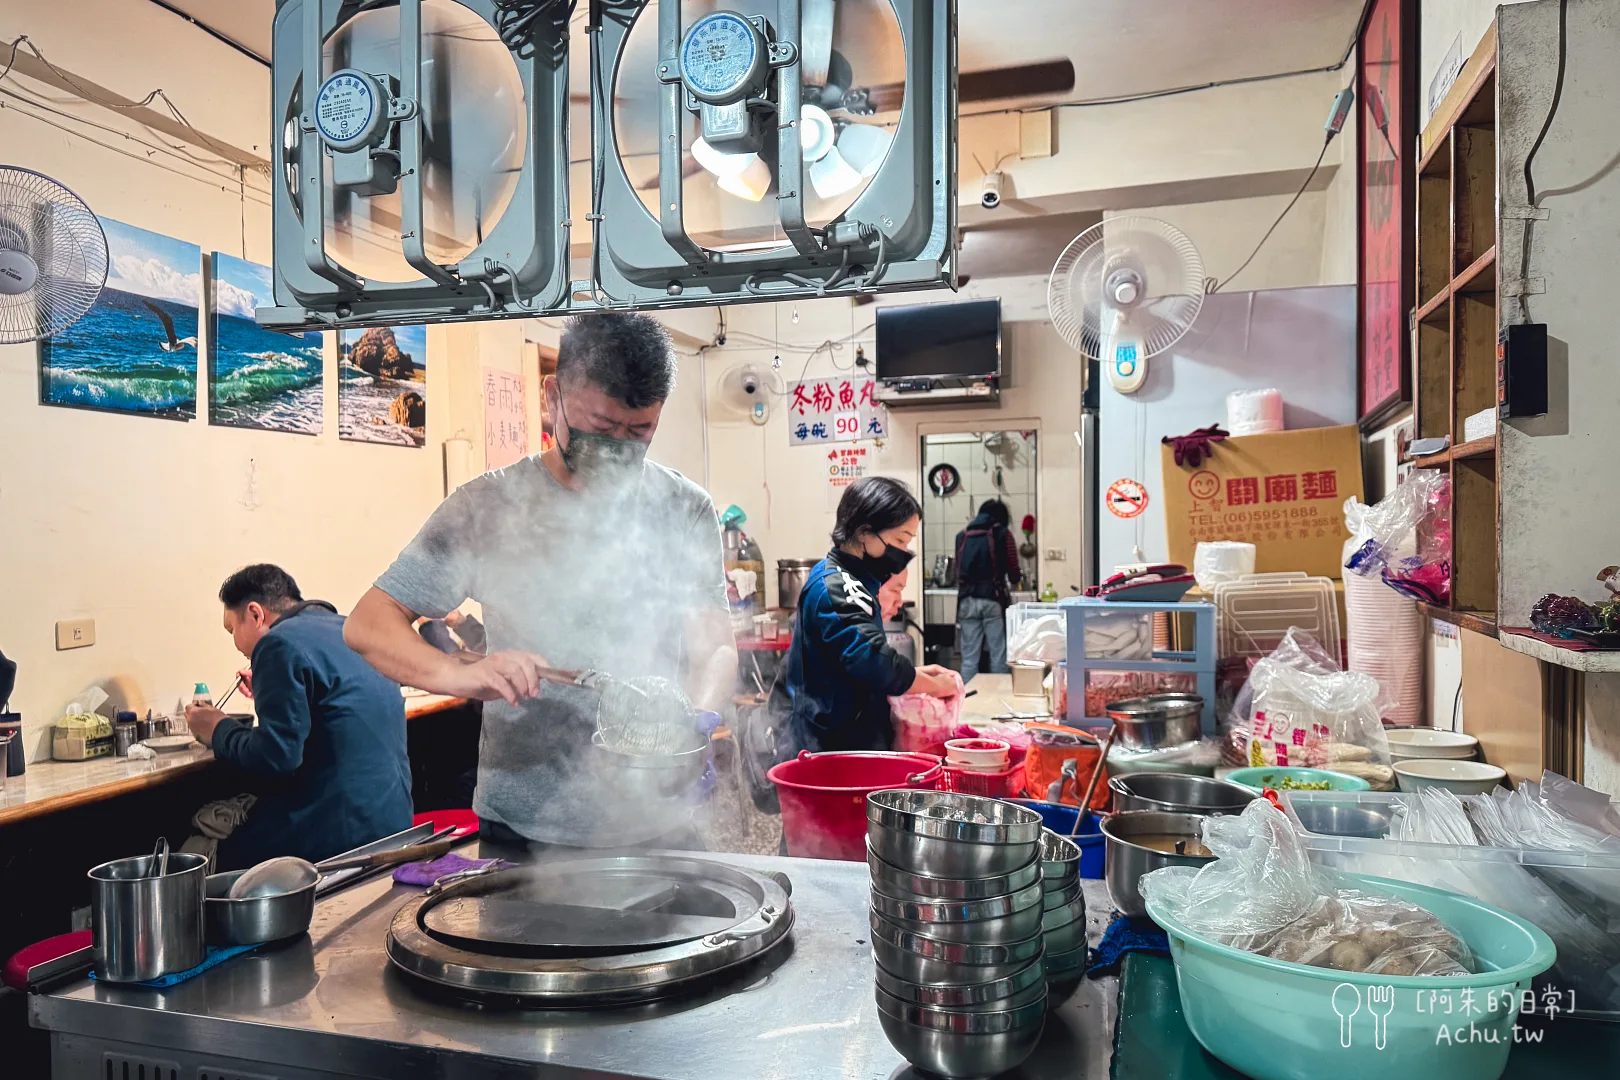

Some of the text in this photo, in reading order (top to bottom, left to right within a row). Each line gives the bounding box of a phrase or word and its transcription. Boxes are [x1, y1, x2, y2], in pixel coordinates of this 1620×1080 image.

[790, 380, 880, 416] 冬粉魚丸
[837, 417, 859, 434] 90
[867, 417, 883, 434] 元
[1226, 470, 1338, 506] 關廟麵
[1188, 499, 1224, 514] 上智
